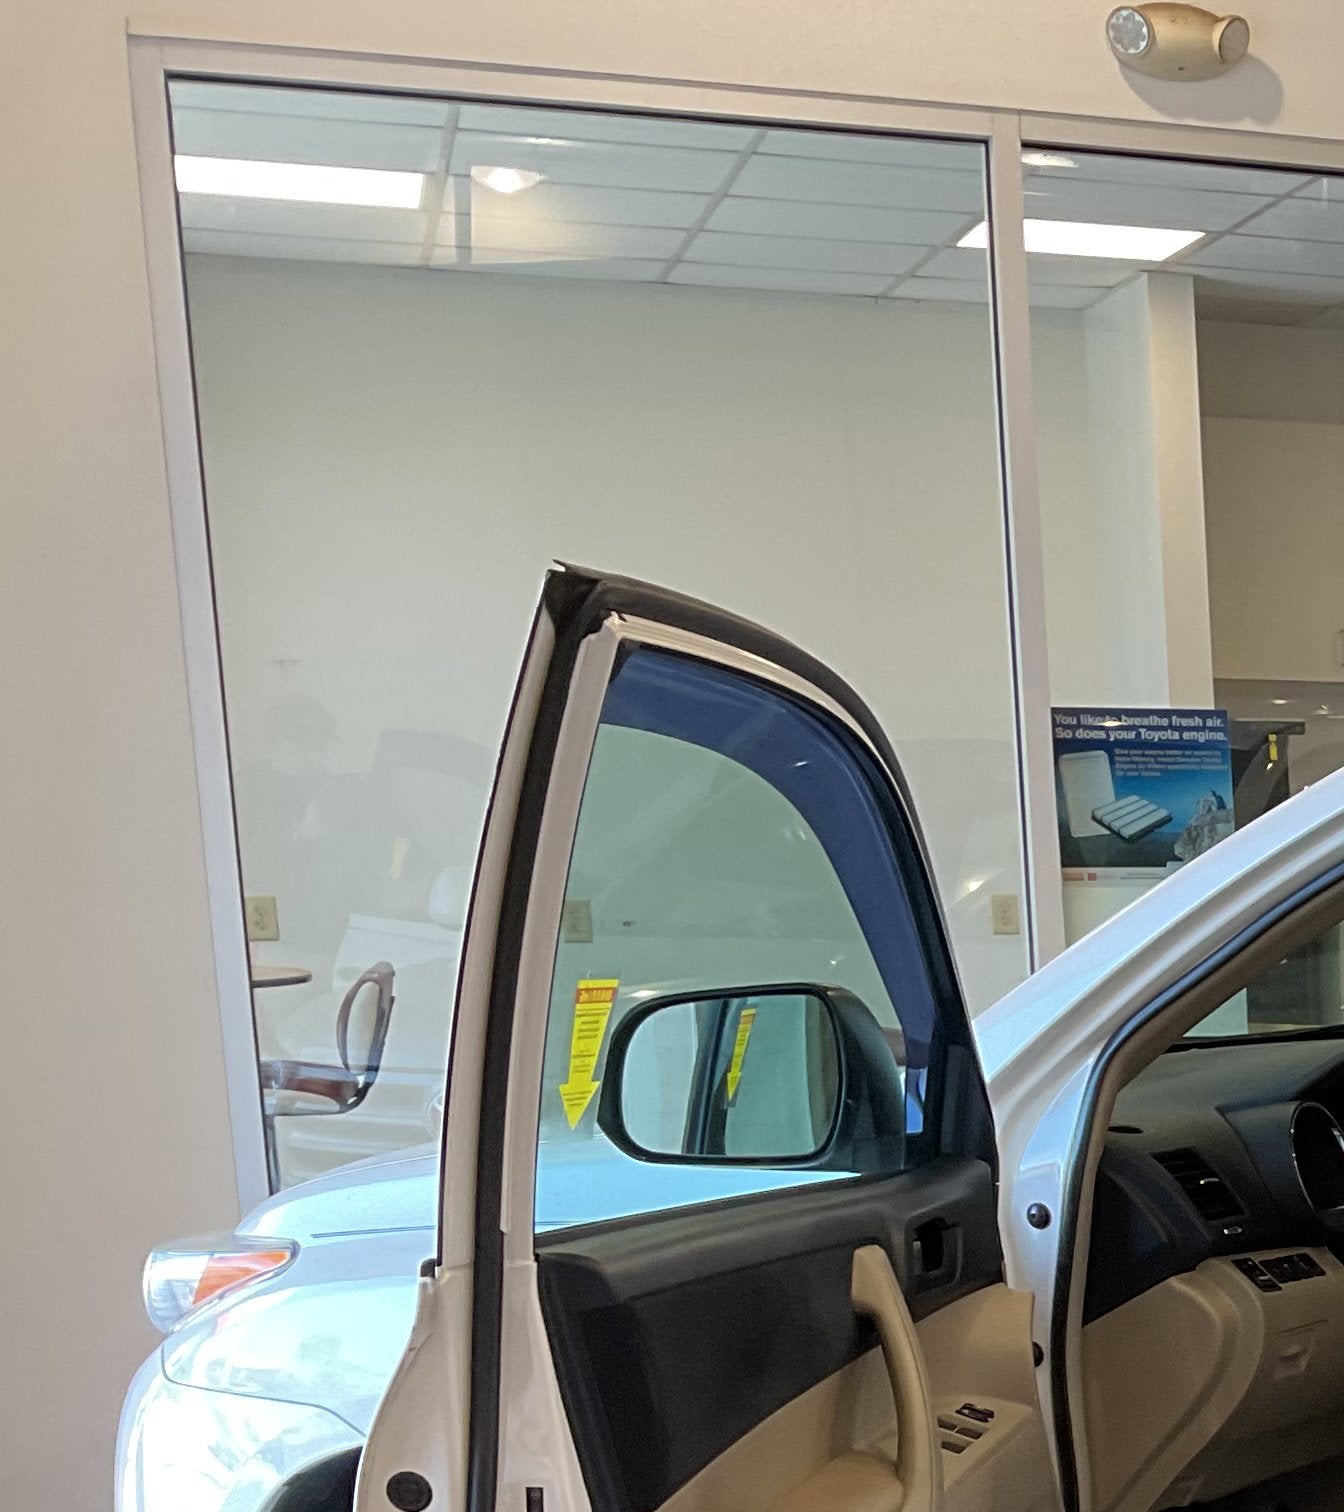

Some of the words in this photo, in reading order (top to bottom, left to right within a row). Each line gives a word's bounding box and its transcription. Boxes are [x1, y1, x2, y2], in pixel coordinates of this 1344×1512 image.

[1053, 713, 1077, 725] You
[1080, 714, 1103, 726] like
[1121, 714, 1169, 727] breathe
[1172, 715, 1203, 727] fresh
[1205, 716, 1225, 728] air.
[1055, 727, 1073, 739] So
[1075, 727, 1107, 739] does
[1109, 728, 1137, 742] your
[1138, 728, 1180, 742] Toyota
[1182, 729, 1228, 743] engine.
